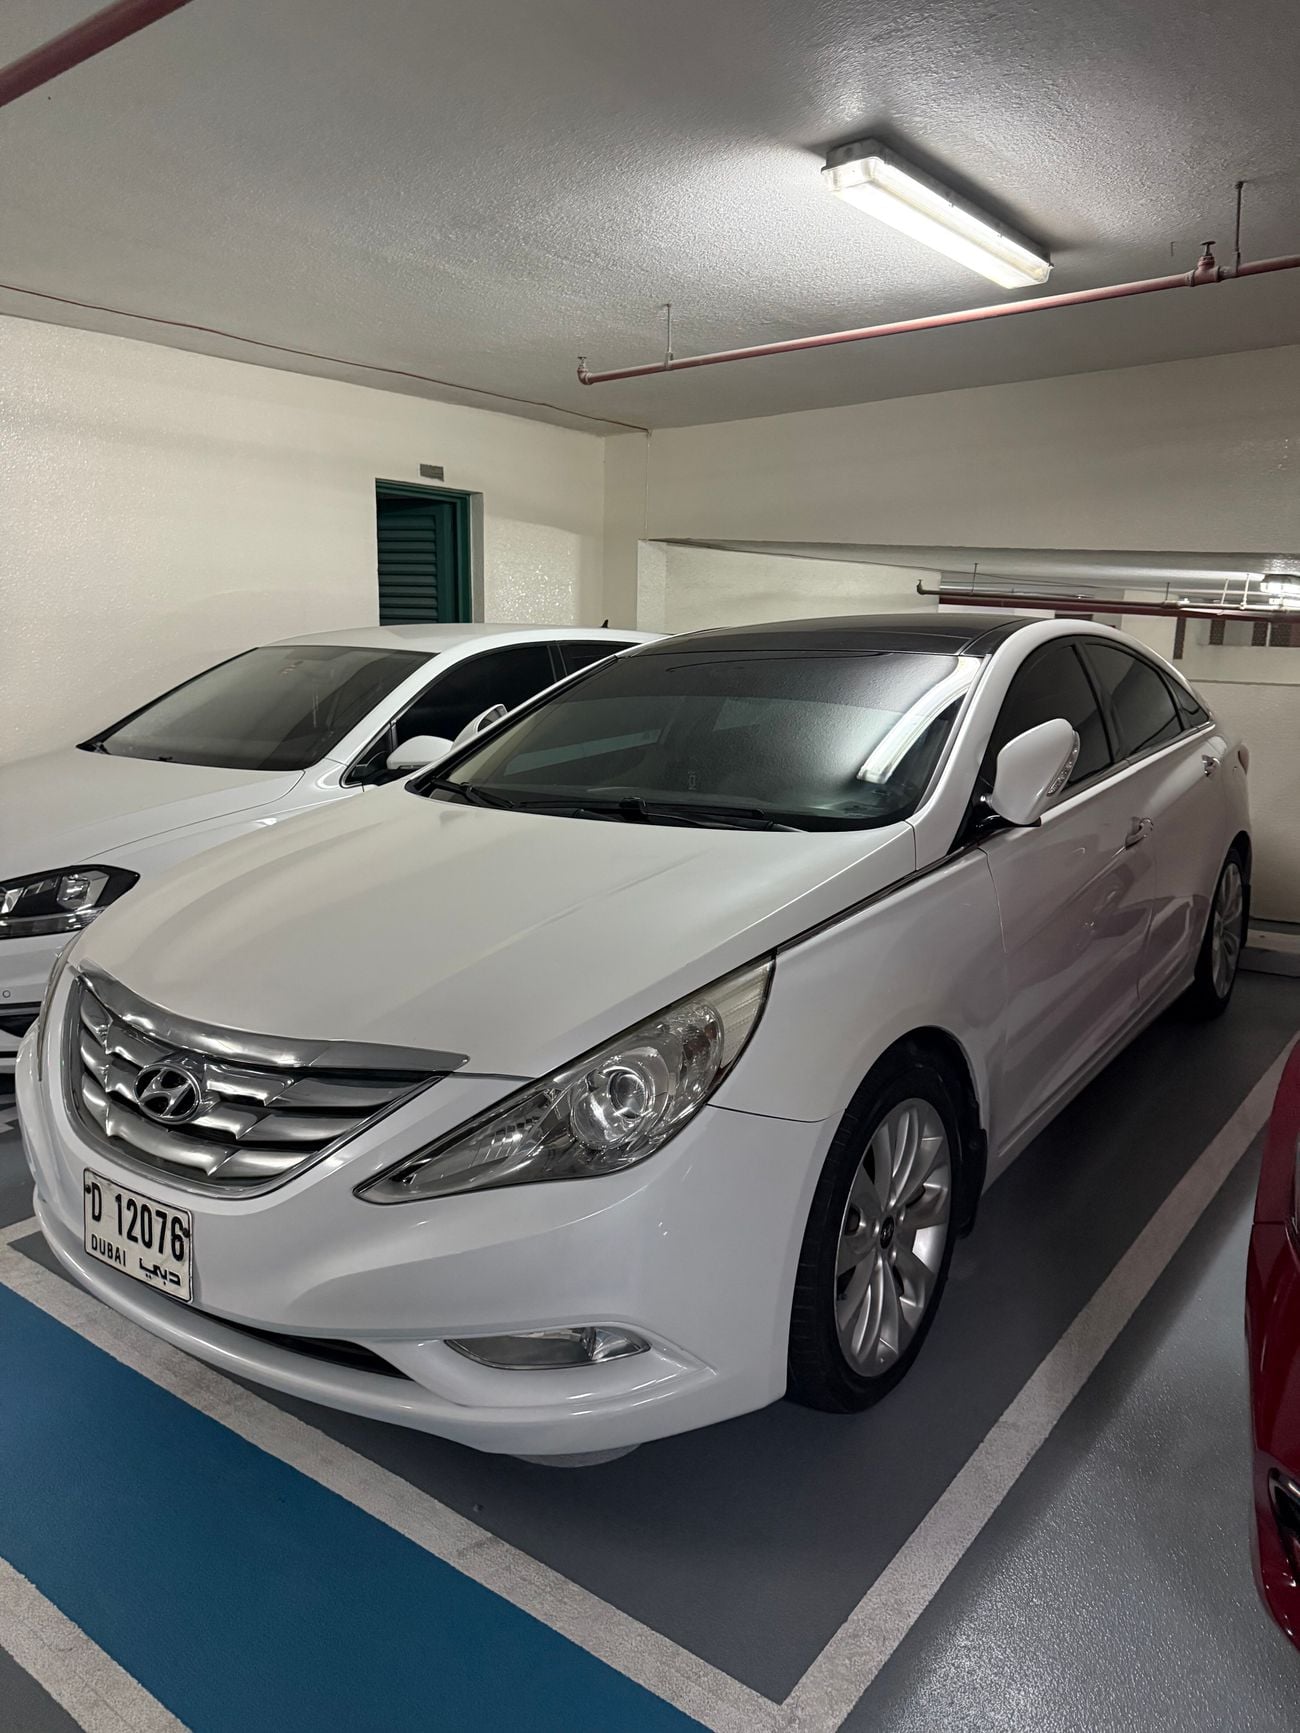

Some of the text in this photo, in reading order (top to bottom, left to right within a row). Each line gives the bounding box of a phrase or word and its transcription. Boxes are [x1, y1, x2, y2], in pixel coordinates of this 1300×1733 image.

[91, 1181, 185, 1262] D 12076
[91, 1233, 126, 1267] DUBAI
[139, 1257, 181, 1286] دبي
